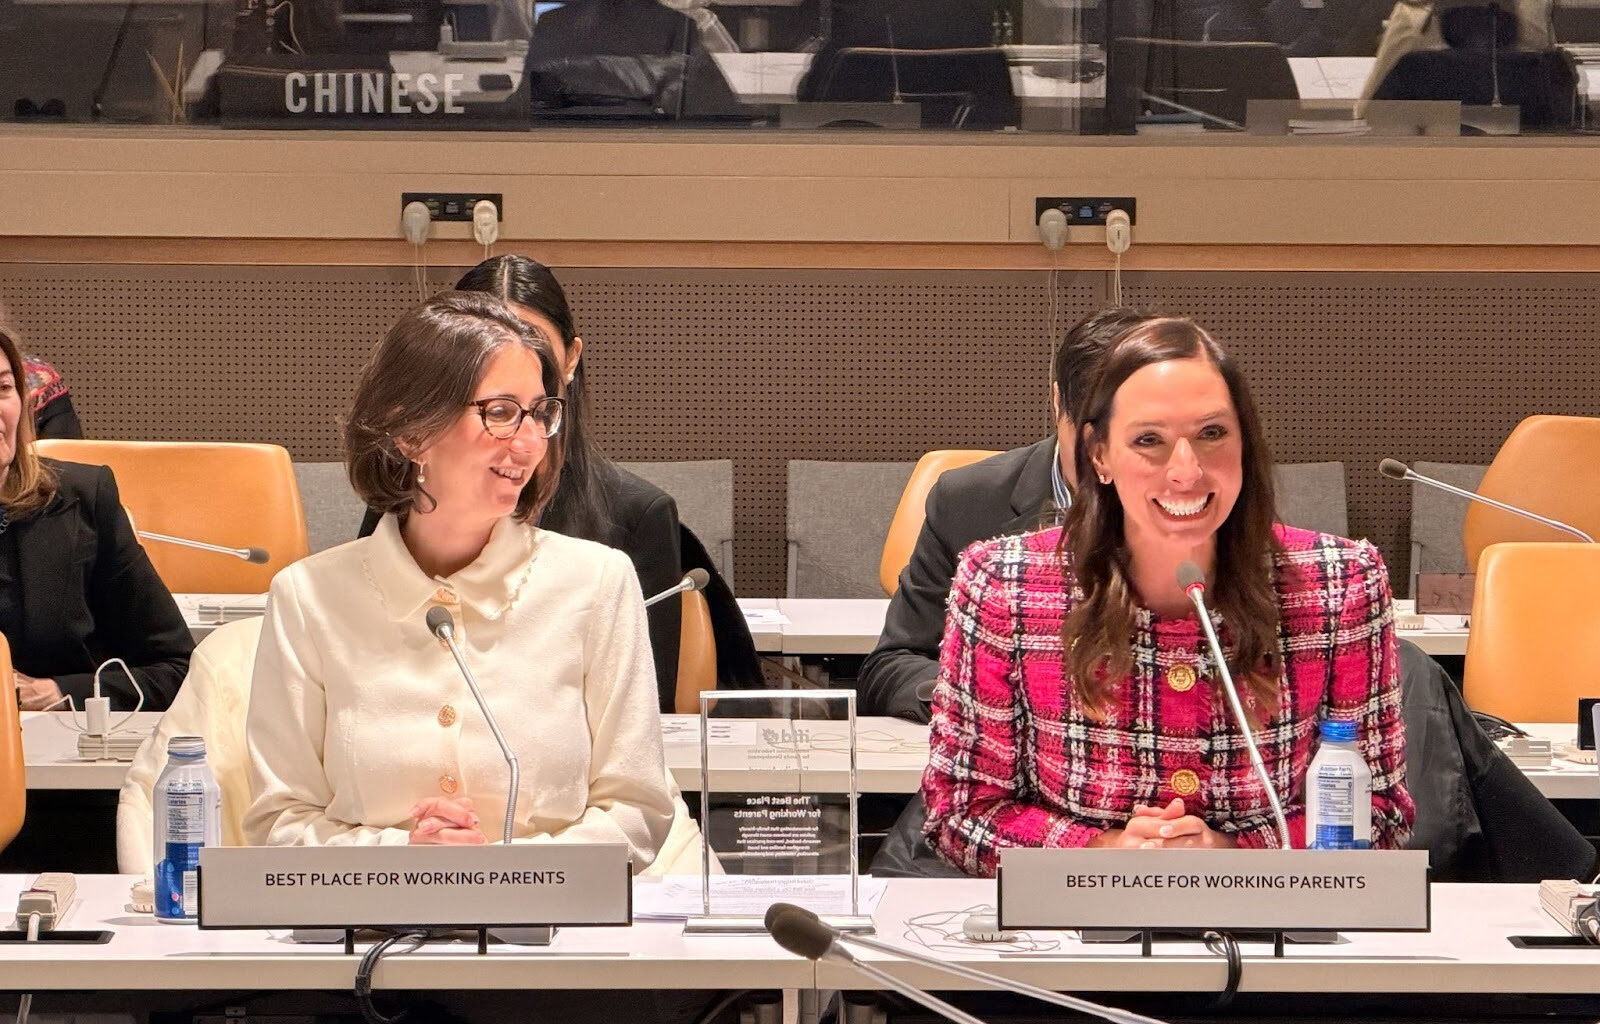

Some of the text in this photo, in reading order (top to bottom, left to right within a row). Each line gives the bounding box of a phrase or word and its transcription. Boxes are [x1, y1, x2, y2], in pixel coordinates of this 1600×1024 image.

[285, 72, 465, 114] CHINESE
[265, 871, 565, 887] BEST PLACE FOR WORKING PARENTS
[1066, 874, 1366, 889] BEST PLACE FOR WORKING PARENTS
